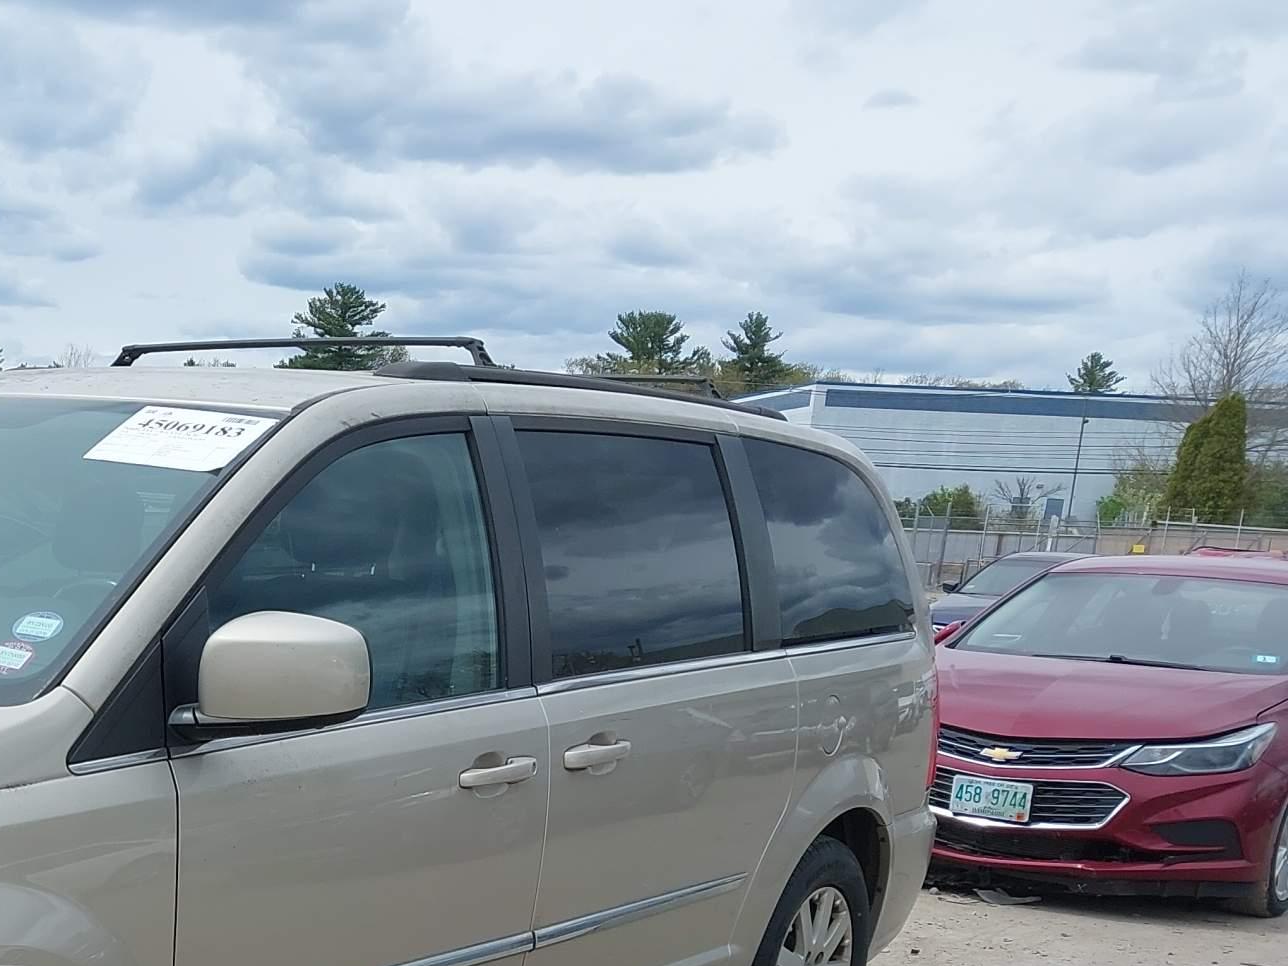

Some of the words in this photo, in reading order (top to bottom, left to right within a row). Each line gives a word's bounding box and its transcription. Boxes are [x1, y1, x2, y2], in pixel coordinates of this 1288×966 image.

[137, 418, 246, 438] 45069183
[955, 783, 983, 804] 458
[990, 788, 1028, 810] 9744
